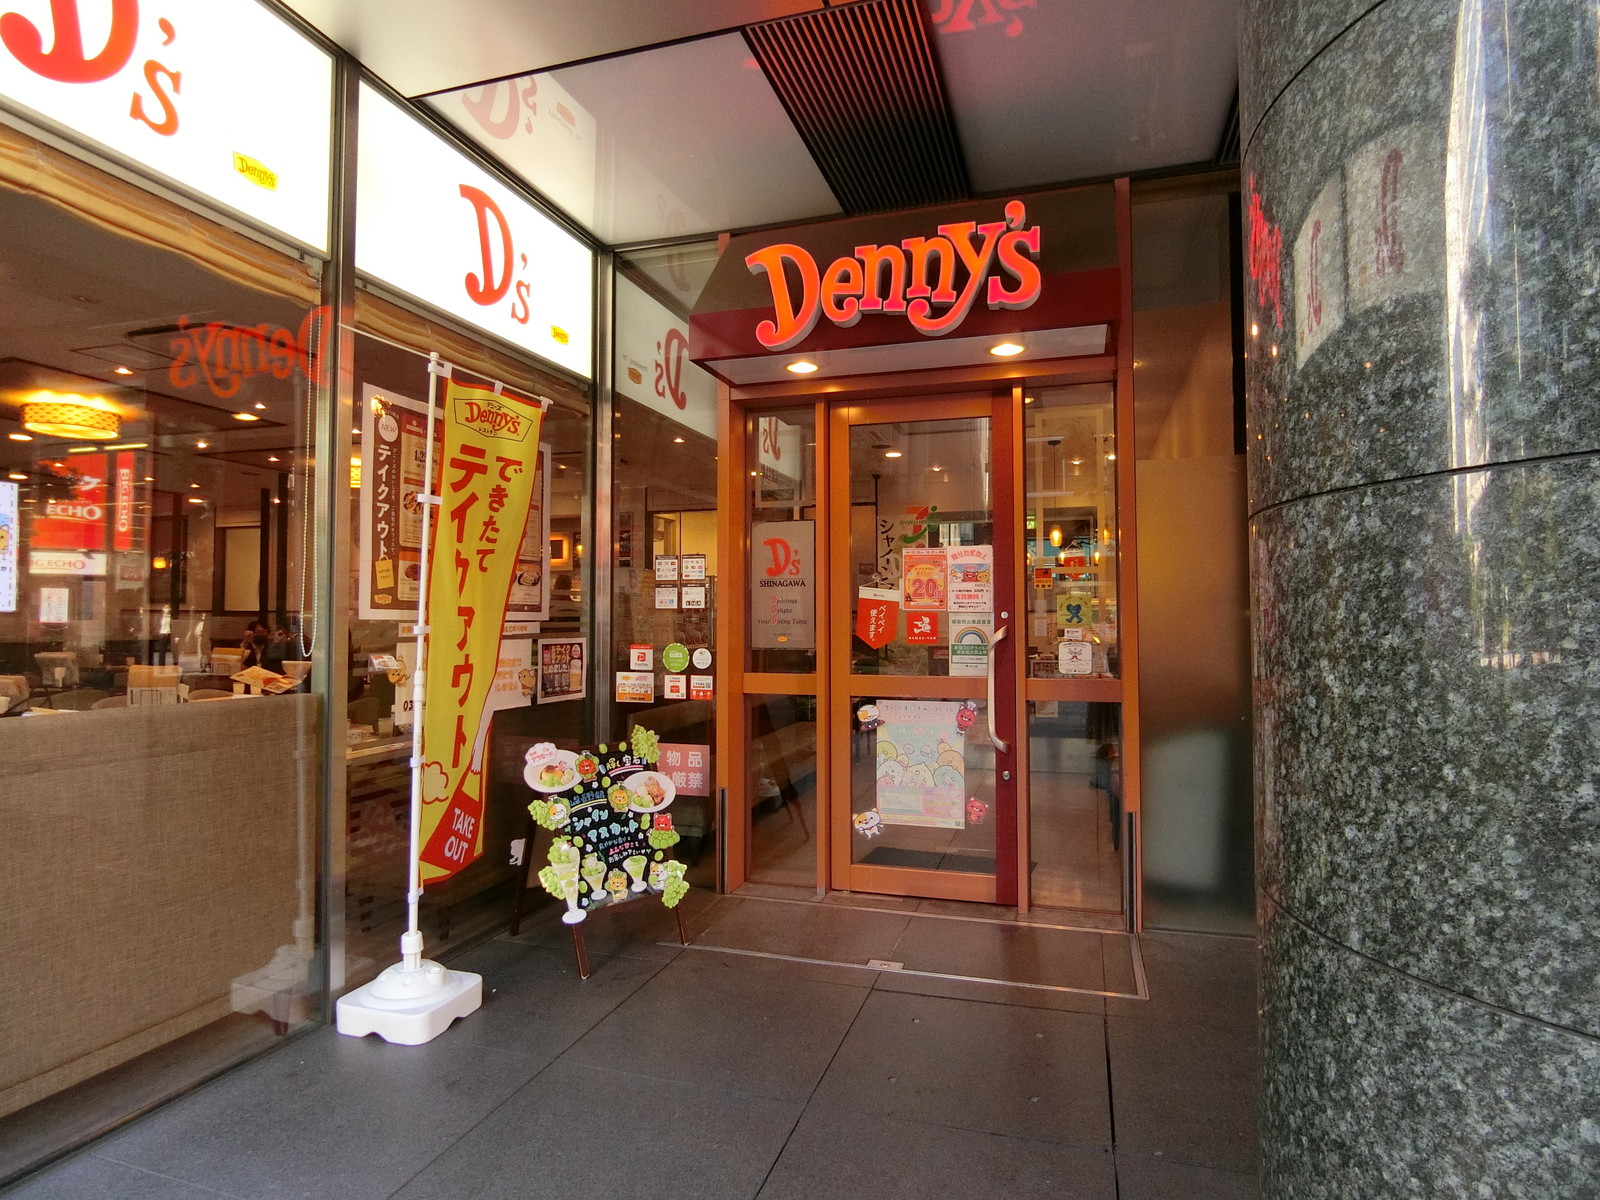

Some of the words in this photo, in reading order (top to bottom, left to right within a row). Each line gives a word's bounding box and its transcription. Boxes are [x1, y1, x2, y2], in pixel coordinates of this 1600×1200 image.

[238, 156, 276, 187] Denny's
[458, 184, 531, 324] D's
[744, 200, 1041, 348] Denny's
[381, 423, 397, 433] NEW
[465, 402, 521, 434] Denny's
[120, 468, 129, 493] BIG
[46, 504, 102, 520] ECHO
[118, 496, 128, 532] ECHO
[376, 444, 391, 559] テイクアウト
[476, 456, 522, 573] できたて
[47, 559, 86, 570] ECHO
[763, 537, 801, 577] D's
[759, 579, 806, 588] SHINAGAWA
[911, 578, 937, 599] 20
[878, 605, 886, 633] ペイペイ
[555, 644, 571, 653] テイク
[659, 750, 703, 767] 物品
[665, 772, 703, 789] 厳禁
[452, 807, 476, 838] TAKE
[572, 809, 608, 831] シャイン
[588, 819, 639, 842] マスカット
[445, 835, 469, 863] OUT
